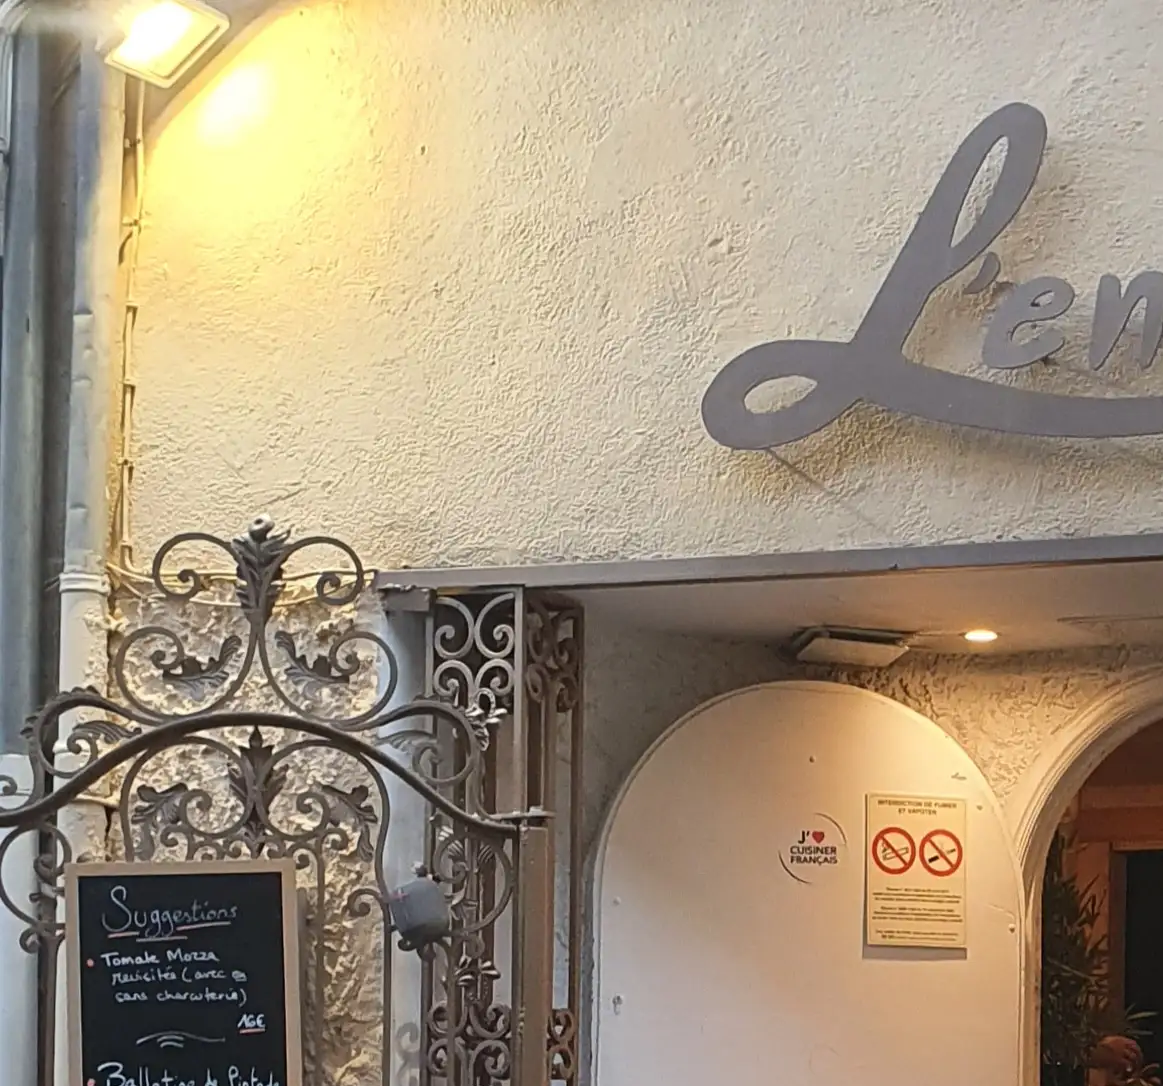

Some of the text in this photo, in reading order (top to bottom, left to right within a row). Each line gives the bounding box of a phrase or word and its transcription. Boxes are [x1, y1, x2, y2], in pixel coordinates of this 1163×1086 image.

[790, 845, 838, 855] CUISINER
[790, 855, 838, 866] FRANÇAIS
[102, 885, 237, 937] Suggestions
[101, 947, 220, 966] Tomate Mozza
[114, 992, 148, 1002] sans
[236, 1013, 266, 1029] 16€
